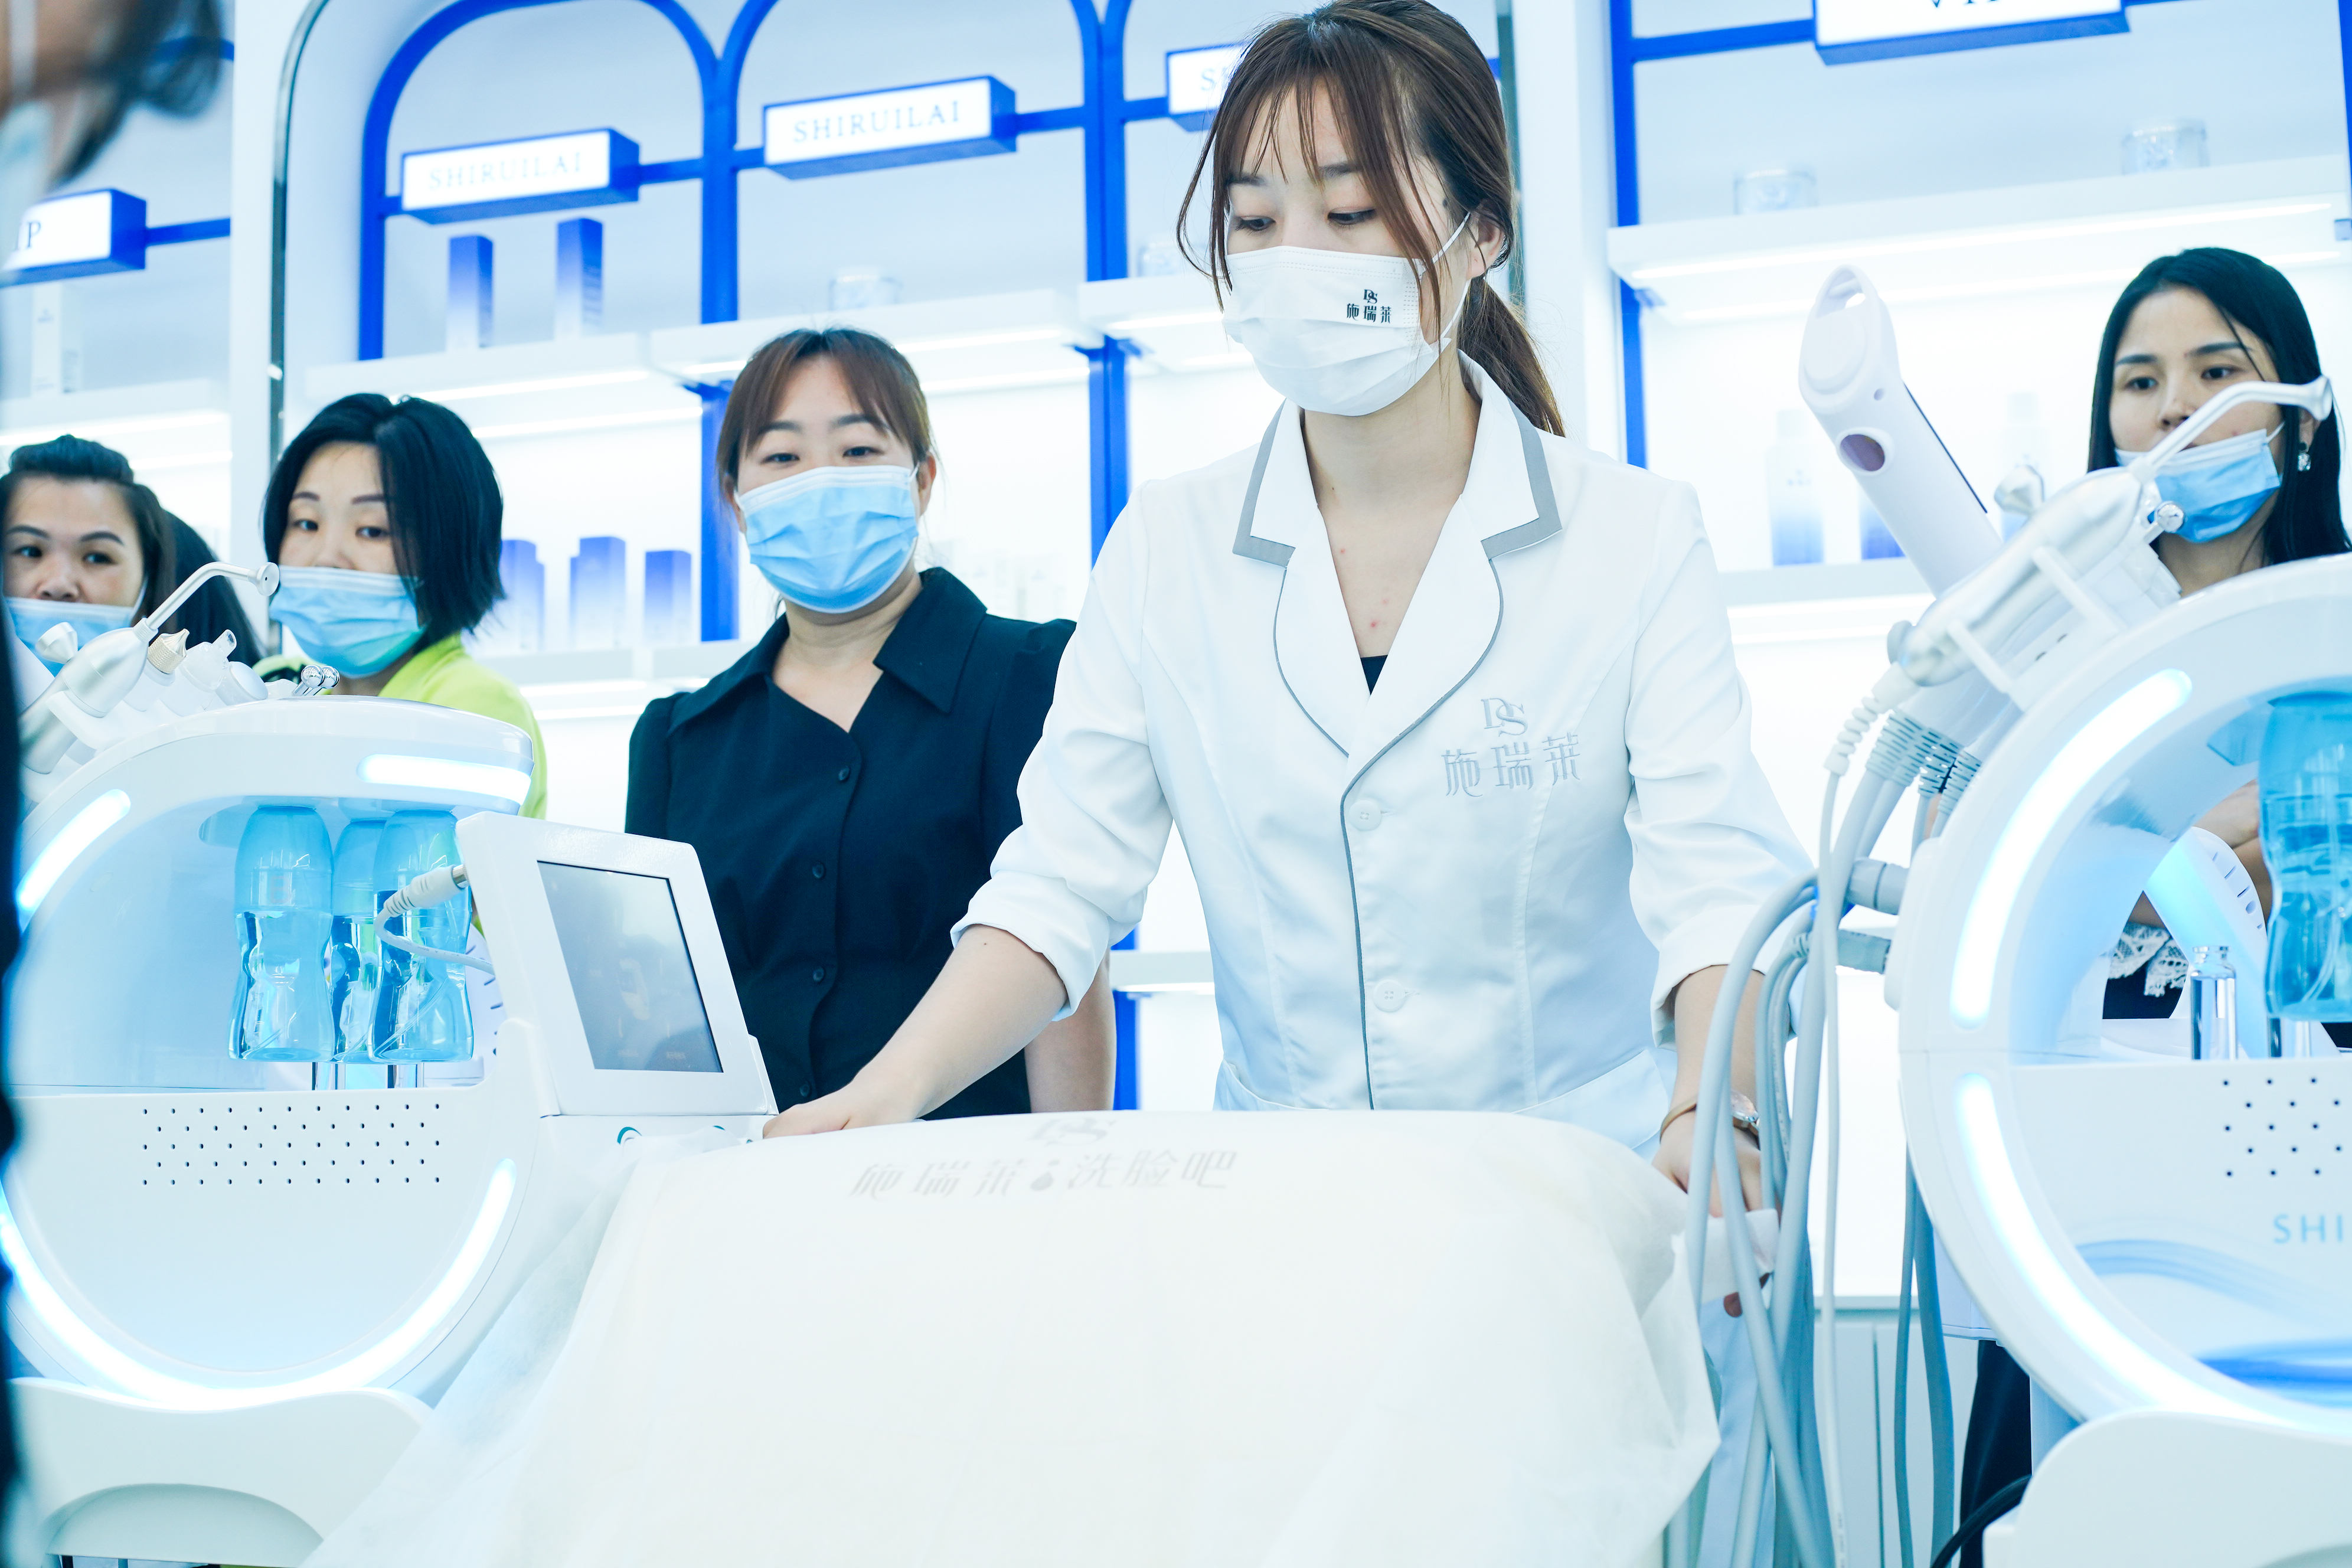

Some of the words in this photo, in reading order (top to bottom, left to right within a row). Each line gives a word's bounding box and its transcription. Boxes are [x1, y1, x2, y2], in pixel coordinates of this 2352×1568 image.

[793, 100, 960, 143] SHIRUILAI
[429, 151, 582, 191] SHIRUILAI
[1347, 303, 1391, 324] 施瑞莱
[1441, 732, 1580, 798] 施瑞莱
